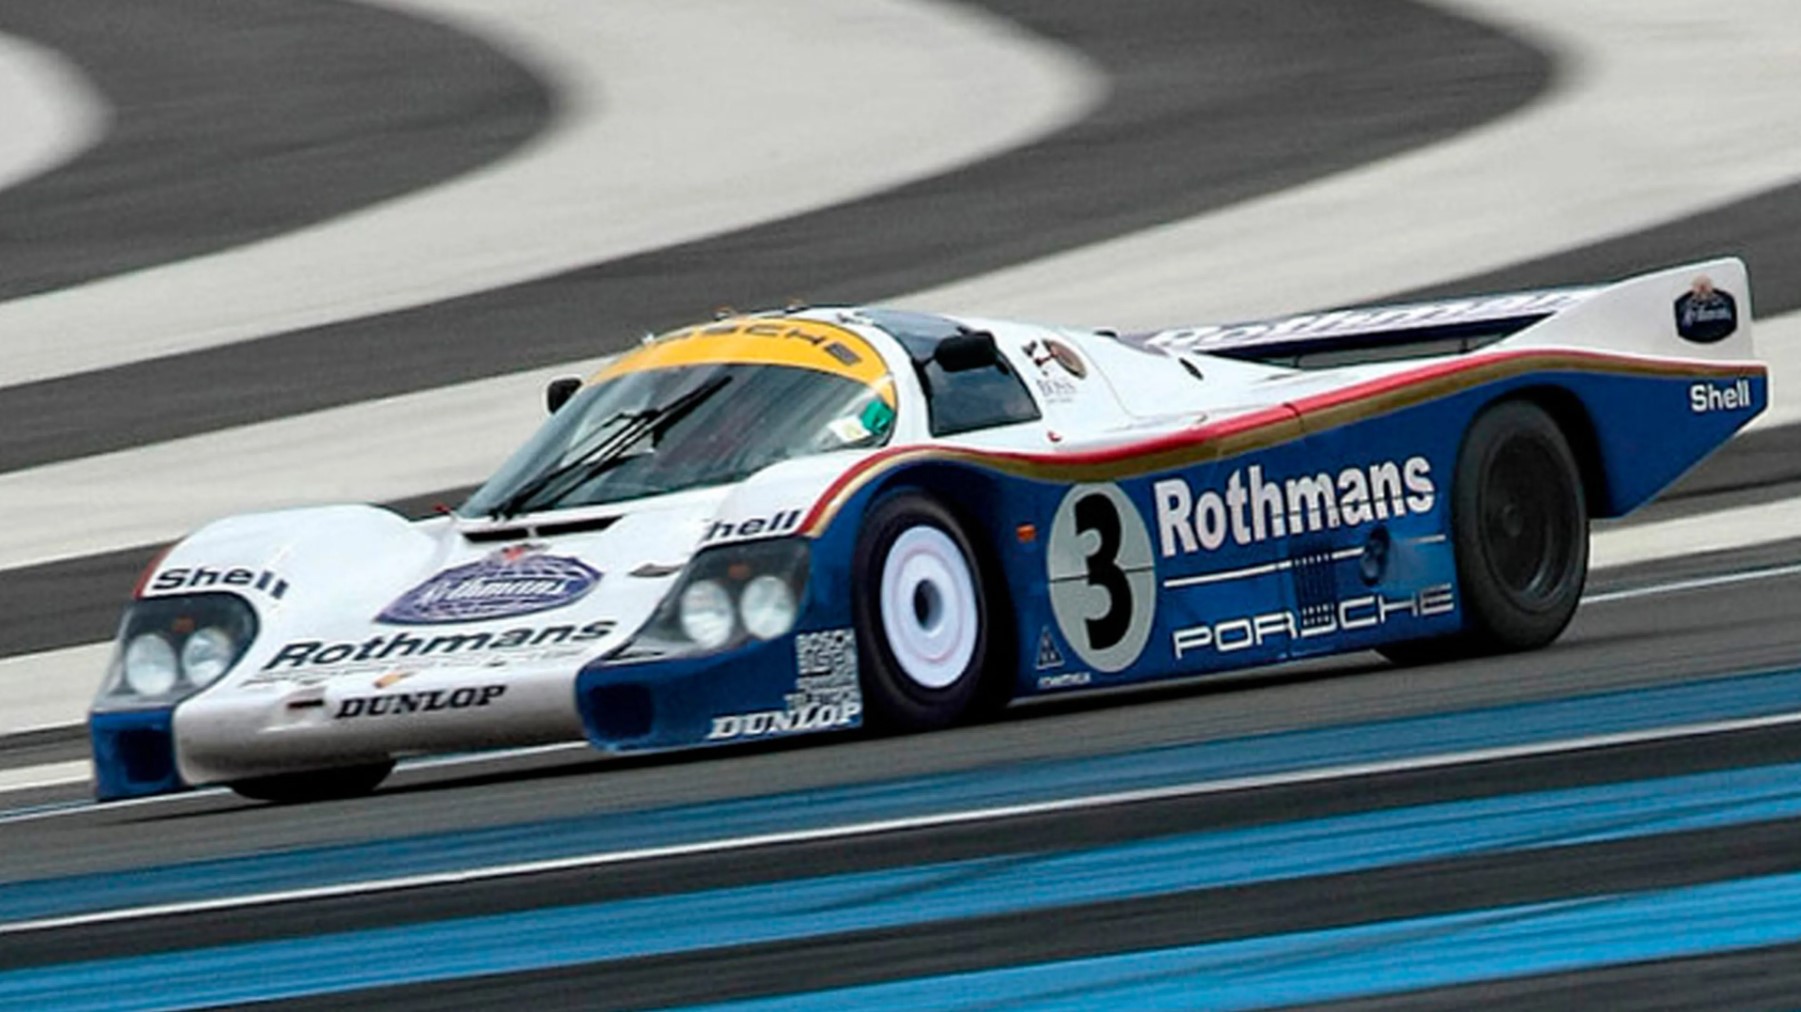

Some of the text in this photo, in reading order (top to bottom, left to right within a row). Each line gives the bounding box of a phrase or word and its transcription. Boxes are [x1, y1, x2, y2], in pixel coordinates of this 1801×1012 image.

[1690, 379, 1750, 412] Shell
[698, 509, 803, 541] hell
[1154, 456, 1435, 557] Rothmans
[152, 567, 288, 599] Shell
[1075, 493, 1133, 650] 3
[1172, 583, 1455, 661] PORSCHE
[262, 618, 617, 671] Rothmans
[335, 685, 508, 719] DUNLOP
[708, 703, 861, 740] DUNLOP
